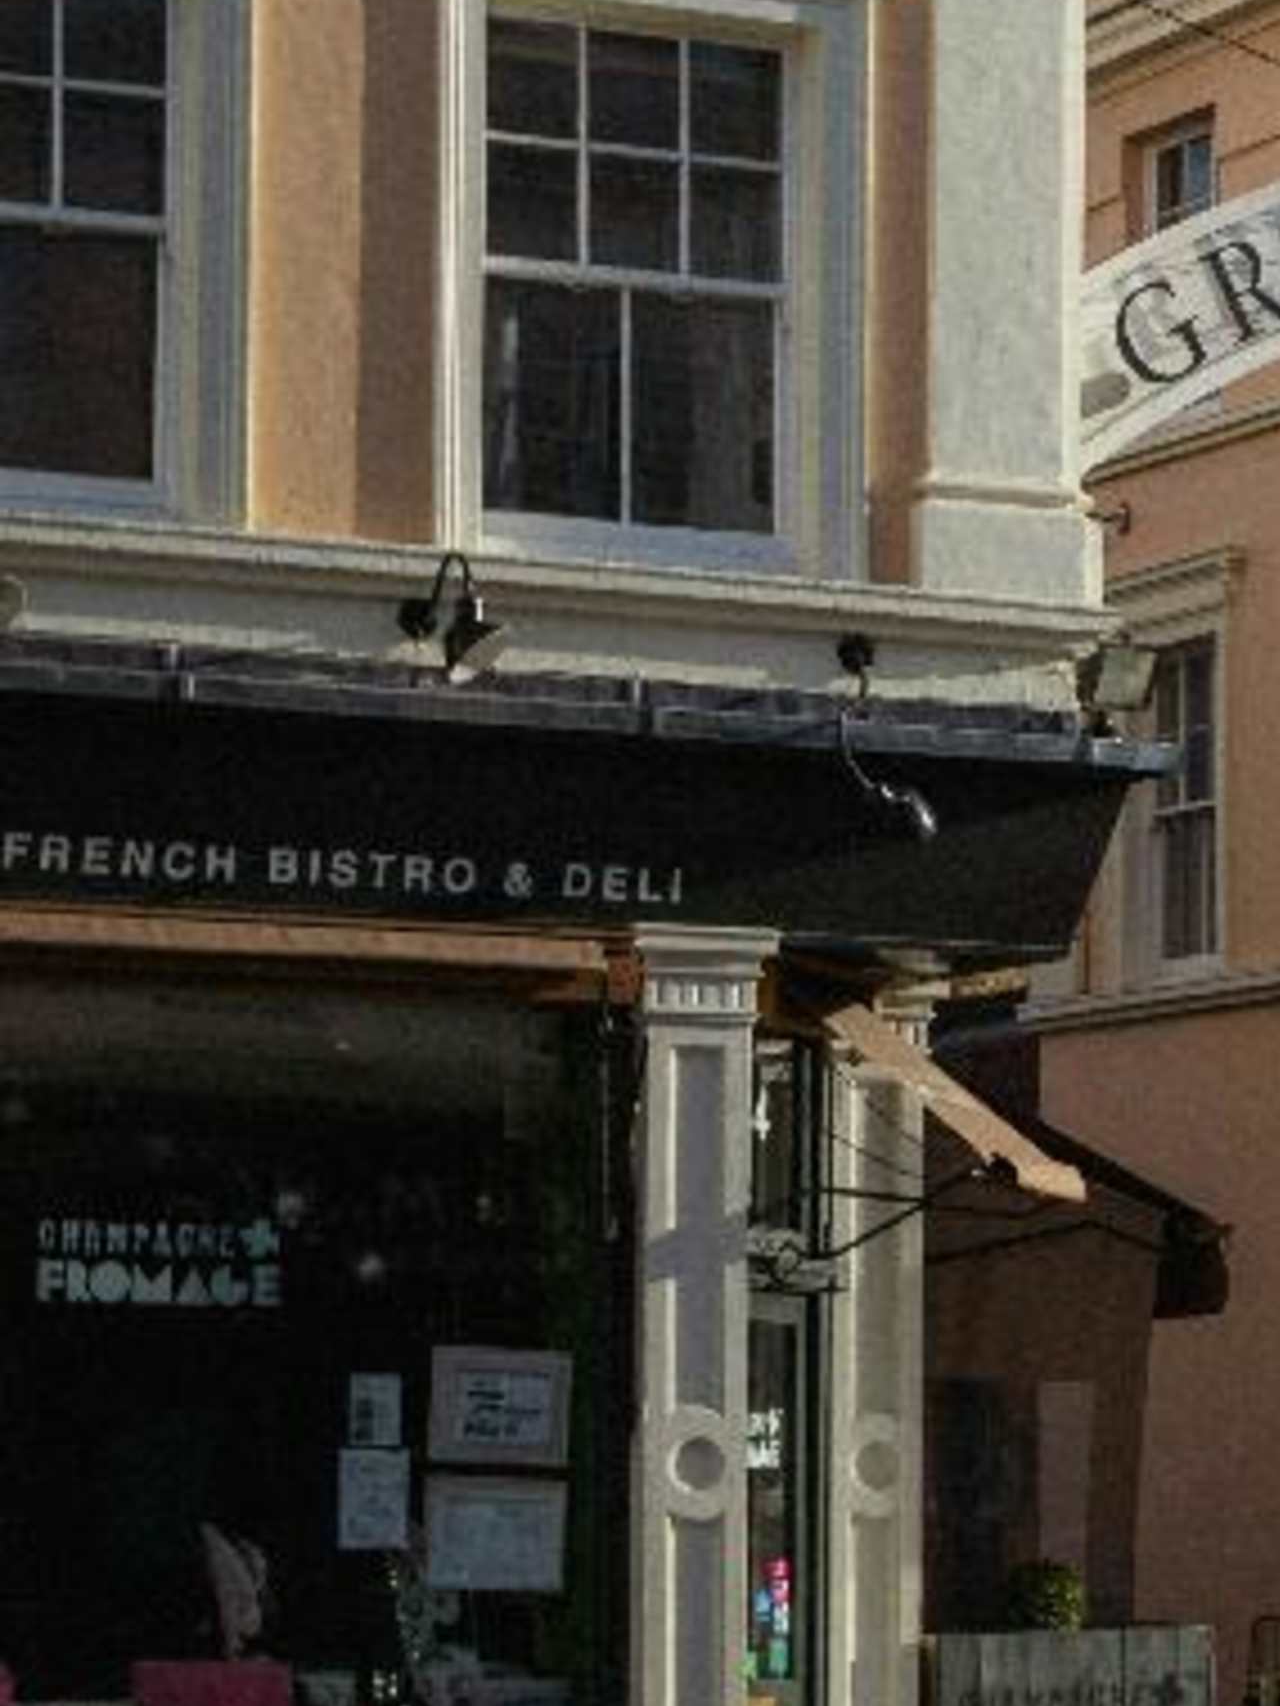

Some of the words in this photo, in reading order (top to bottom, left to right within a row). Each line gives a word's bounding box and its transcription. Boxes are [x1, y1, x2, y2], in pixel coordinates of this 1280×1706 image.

[2, 832, 237, 883] FRENCH
[268, 849, 477, 893] BISTRO
[503, 862, 532, 896] &
[563, 864, 682, 903] DELI
[36, 1258, 282, 1307] FROMAGE
